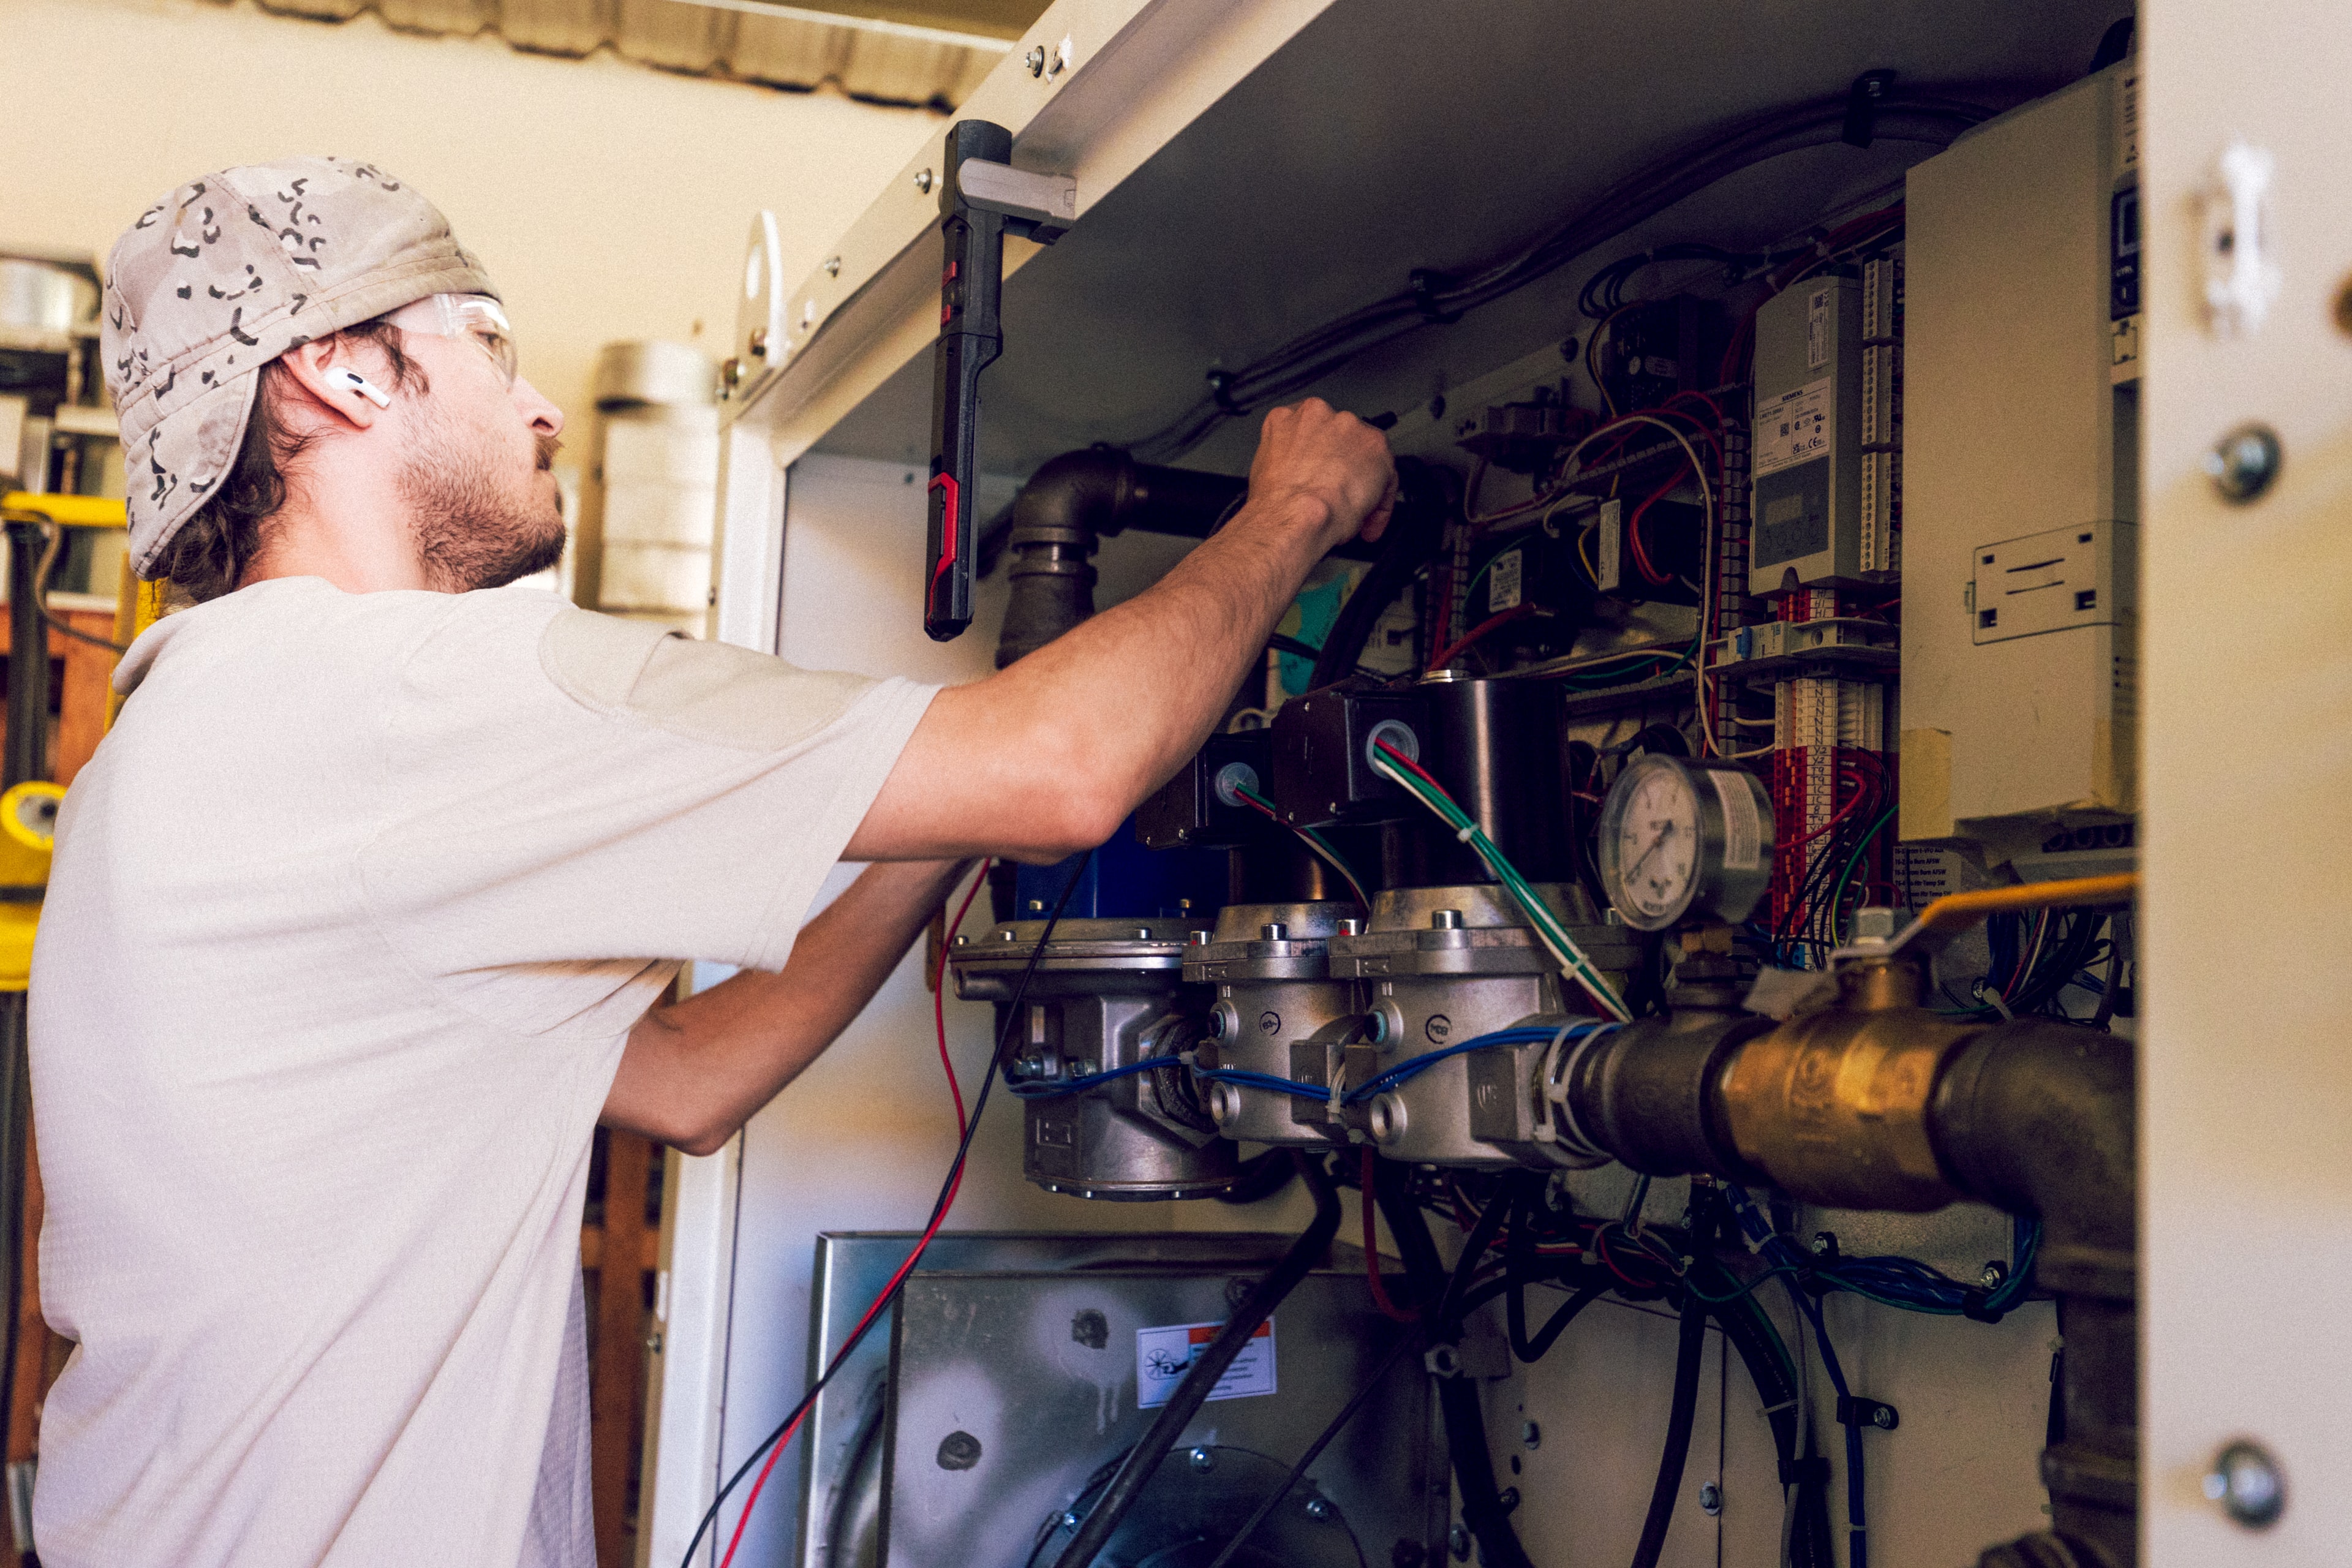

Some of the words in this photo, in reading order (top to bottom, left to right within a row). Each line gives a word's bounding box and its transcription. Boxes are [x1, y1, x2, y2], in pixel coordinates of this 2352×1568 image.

[1782, 390, 1803, 401] SIEMENS
[1815, 688, 1823, 697] N
[1817, 697, 1824, 707] N
[1816, 707, 1823, 716] N
[1814, 717, 1823, 726] N
[1814, 746, 1826, 756] Y2
[1813, 756, 1825, 765] Y2
[1809, 815, 1823, 824] T4
